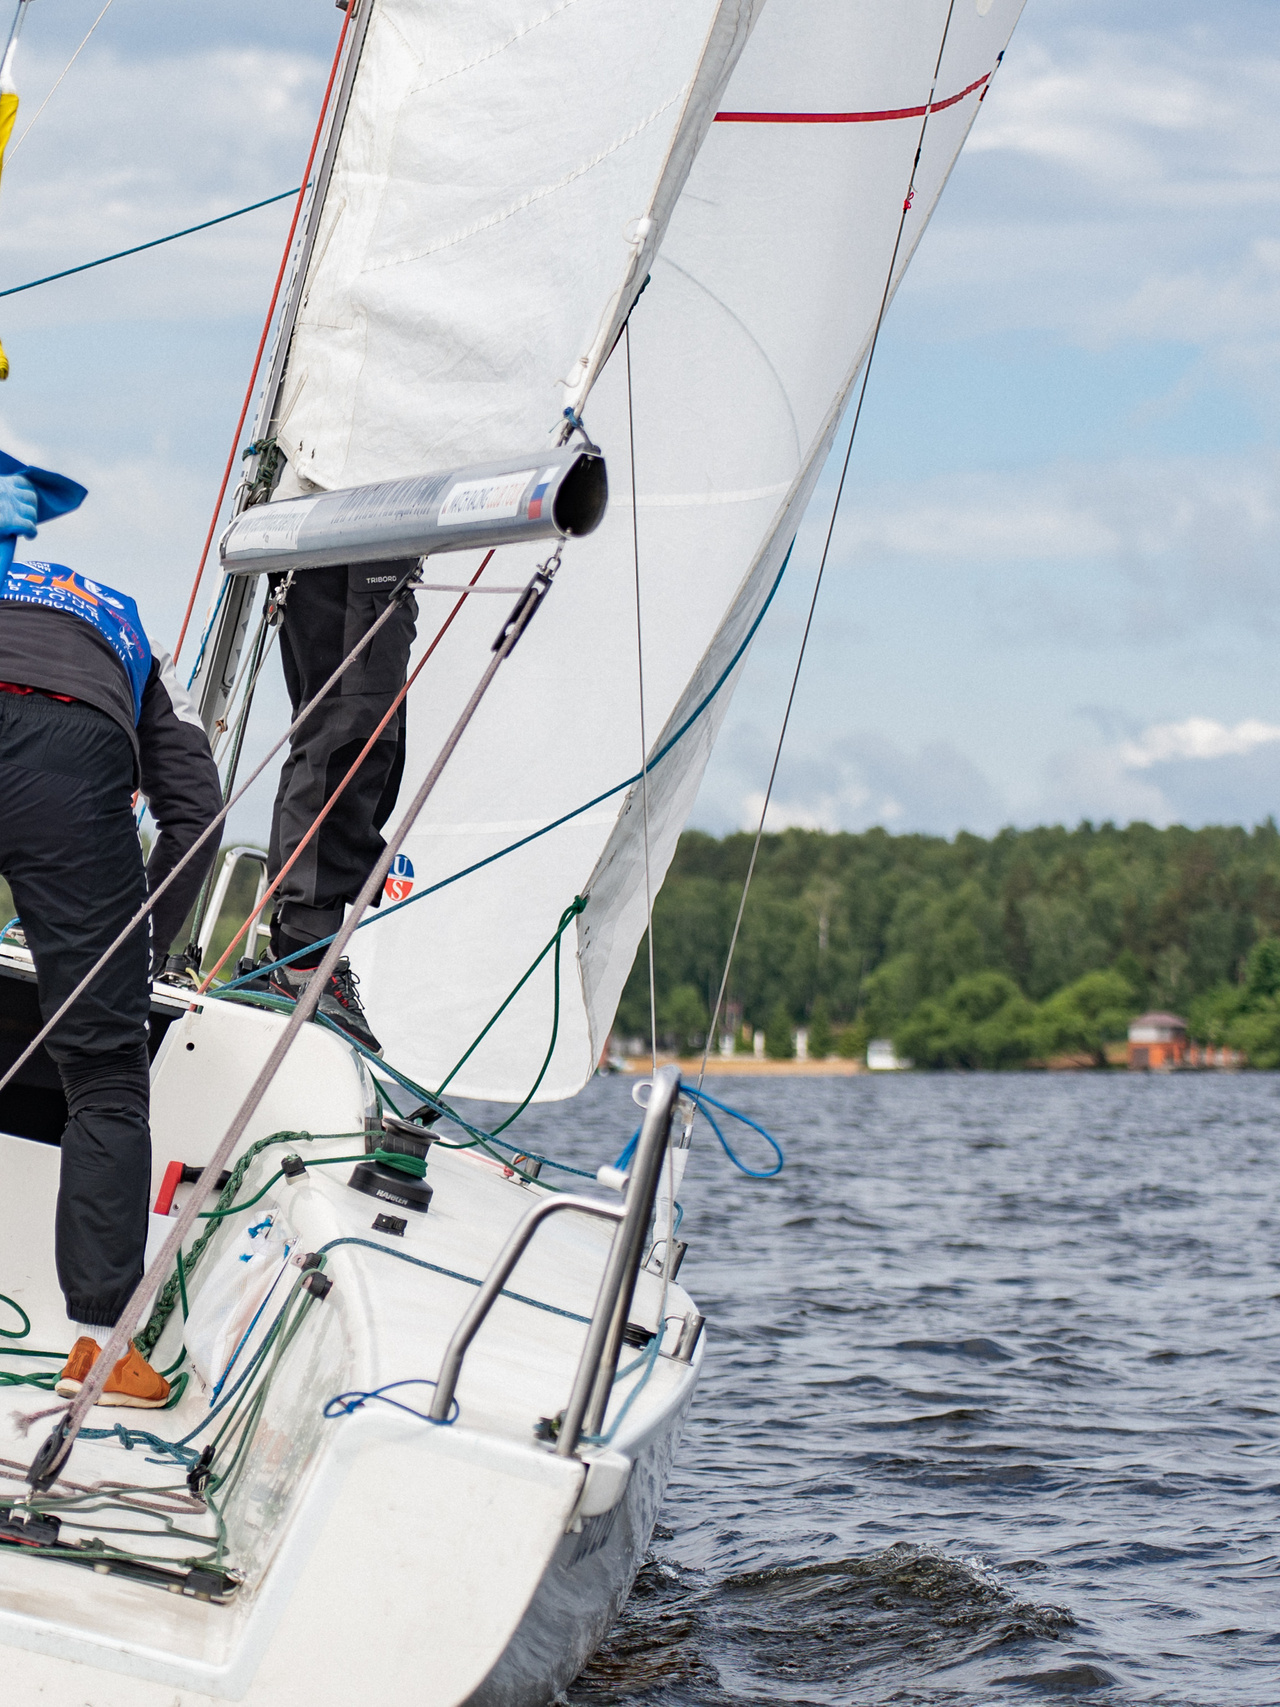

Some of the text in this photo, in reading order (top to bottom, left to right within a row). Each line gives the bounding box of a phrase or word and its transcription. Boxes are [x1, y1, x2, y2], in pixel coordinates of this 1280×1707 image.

[366, 576, 397, 584] TRIBORD
[393, 856, 409, 876] U
[391, 881, 404, 901] S
